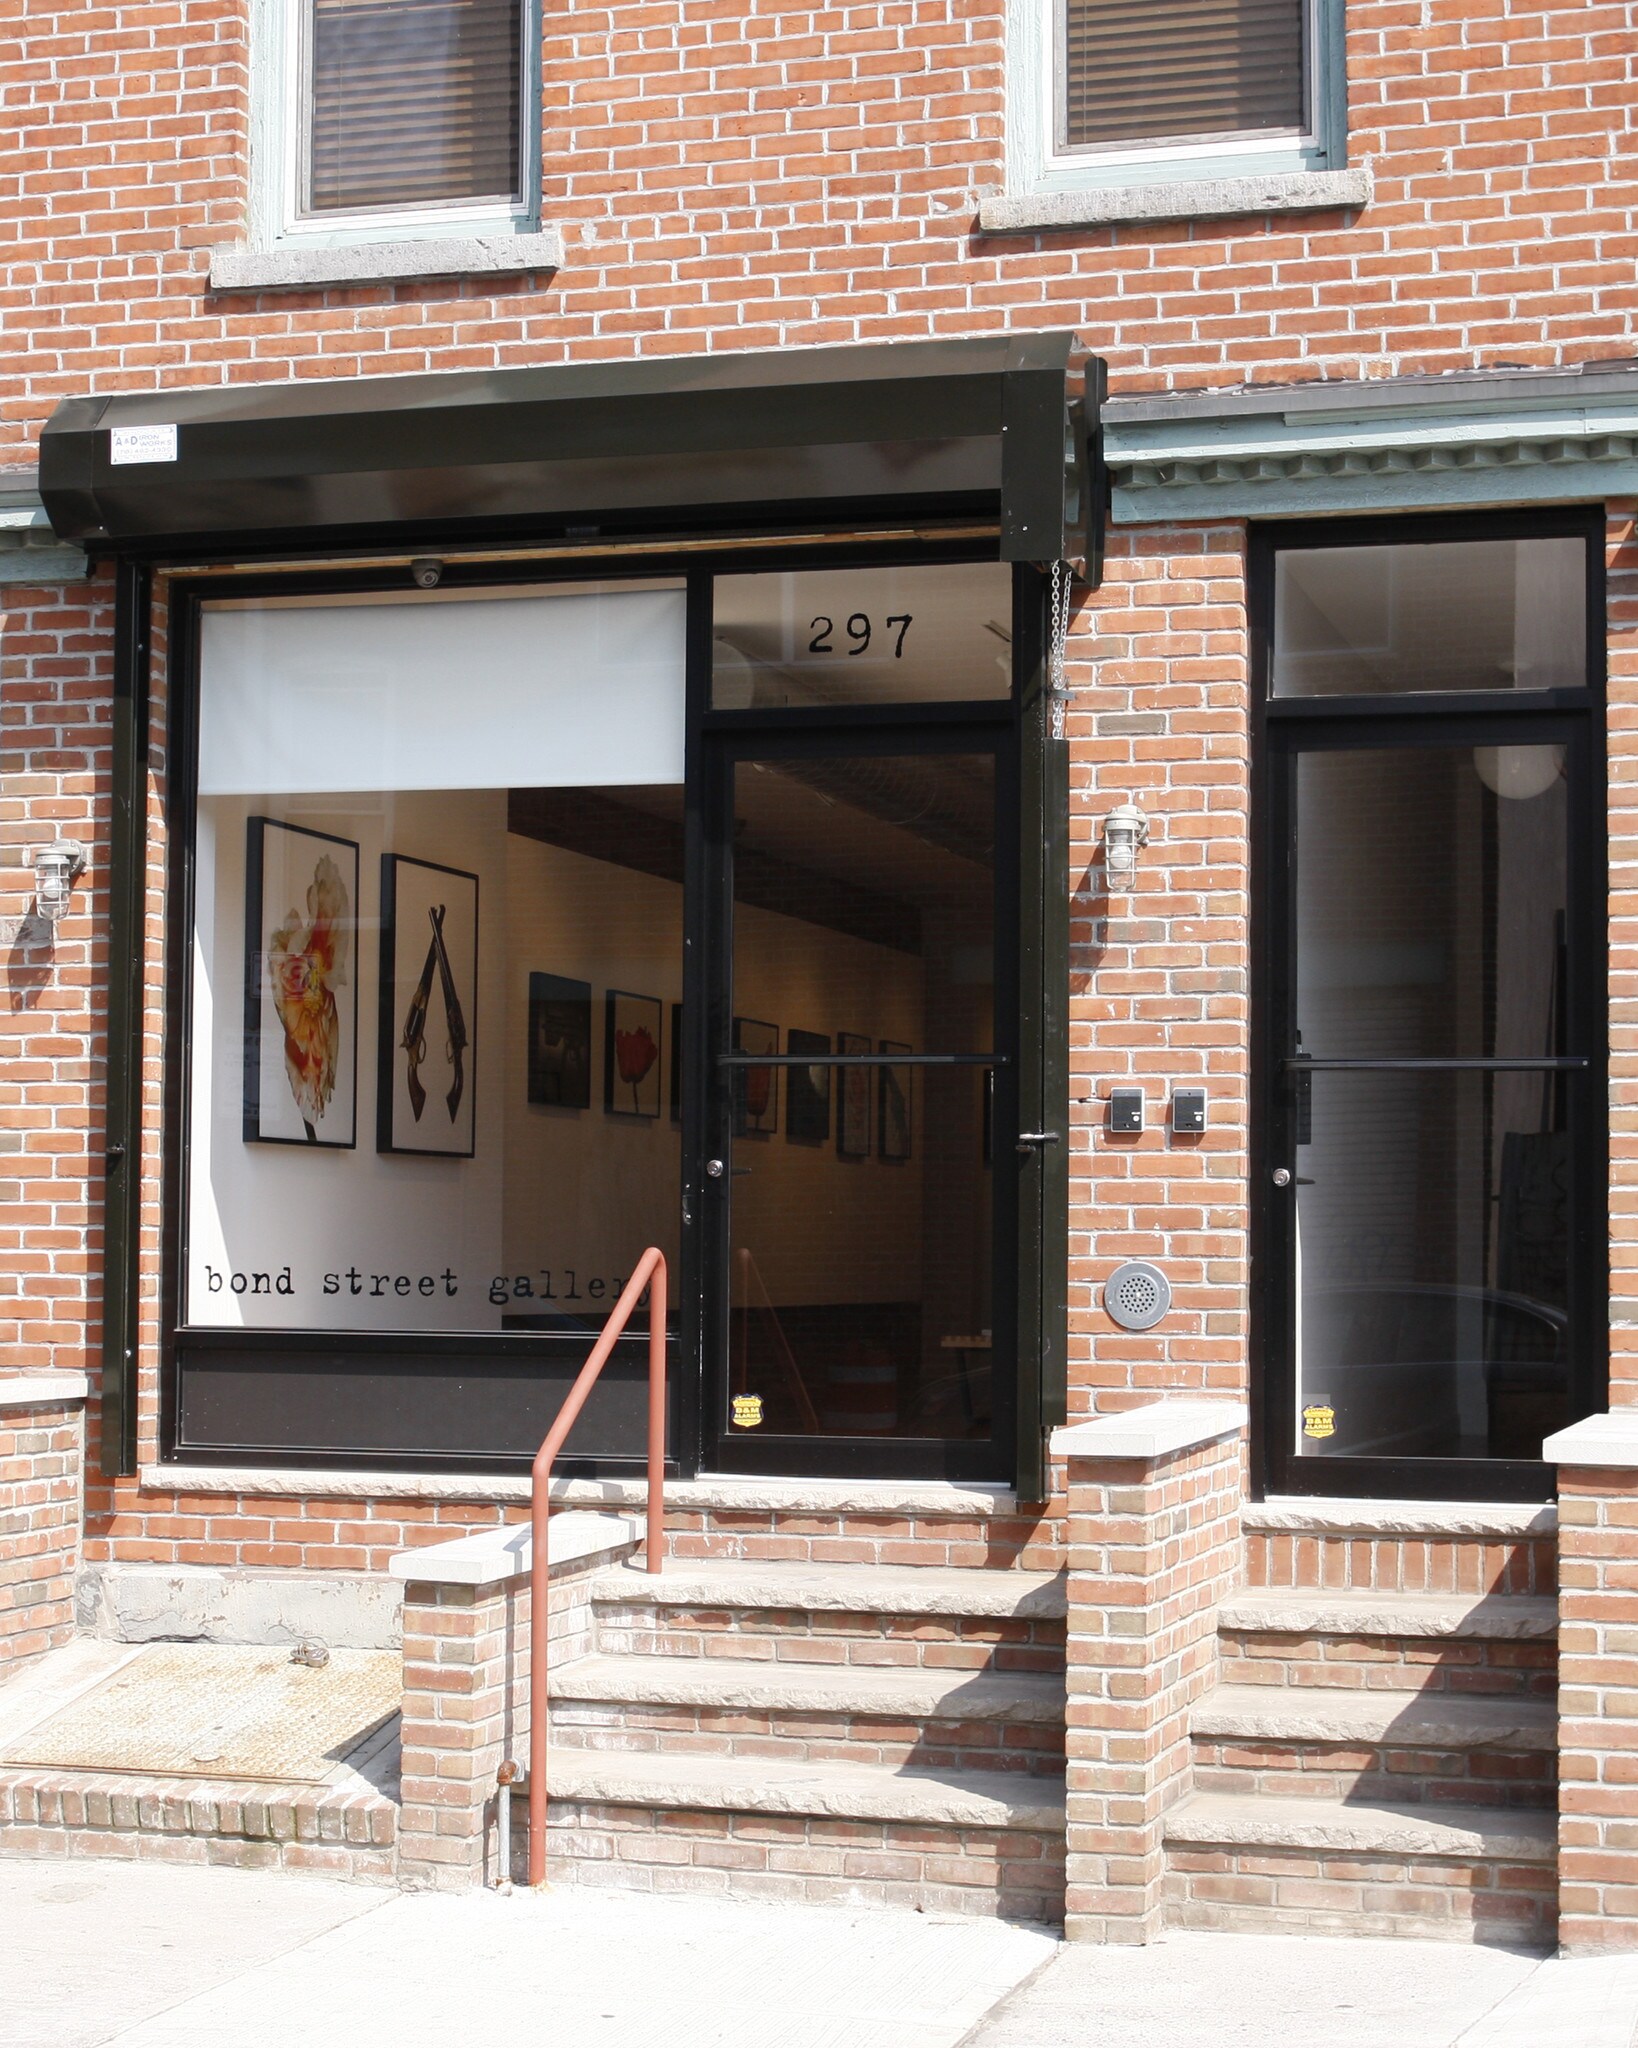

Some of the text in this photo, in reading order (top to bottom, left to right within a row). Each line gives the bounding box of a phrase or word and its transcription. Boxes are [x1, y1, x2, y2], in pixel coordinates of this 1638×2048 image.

[115, 437, 122, 446] A
[130, 435, 139, 446] D
[139, 439, 172, 447] WORKS
[808, 612, 913, 658] 297
[204, 1265, 295, 1295] bond
[322, 1266, 458, 1297] street
